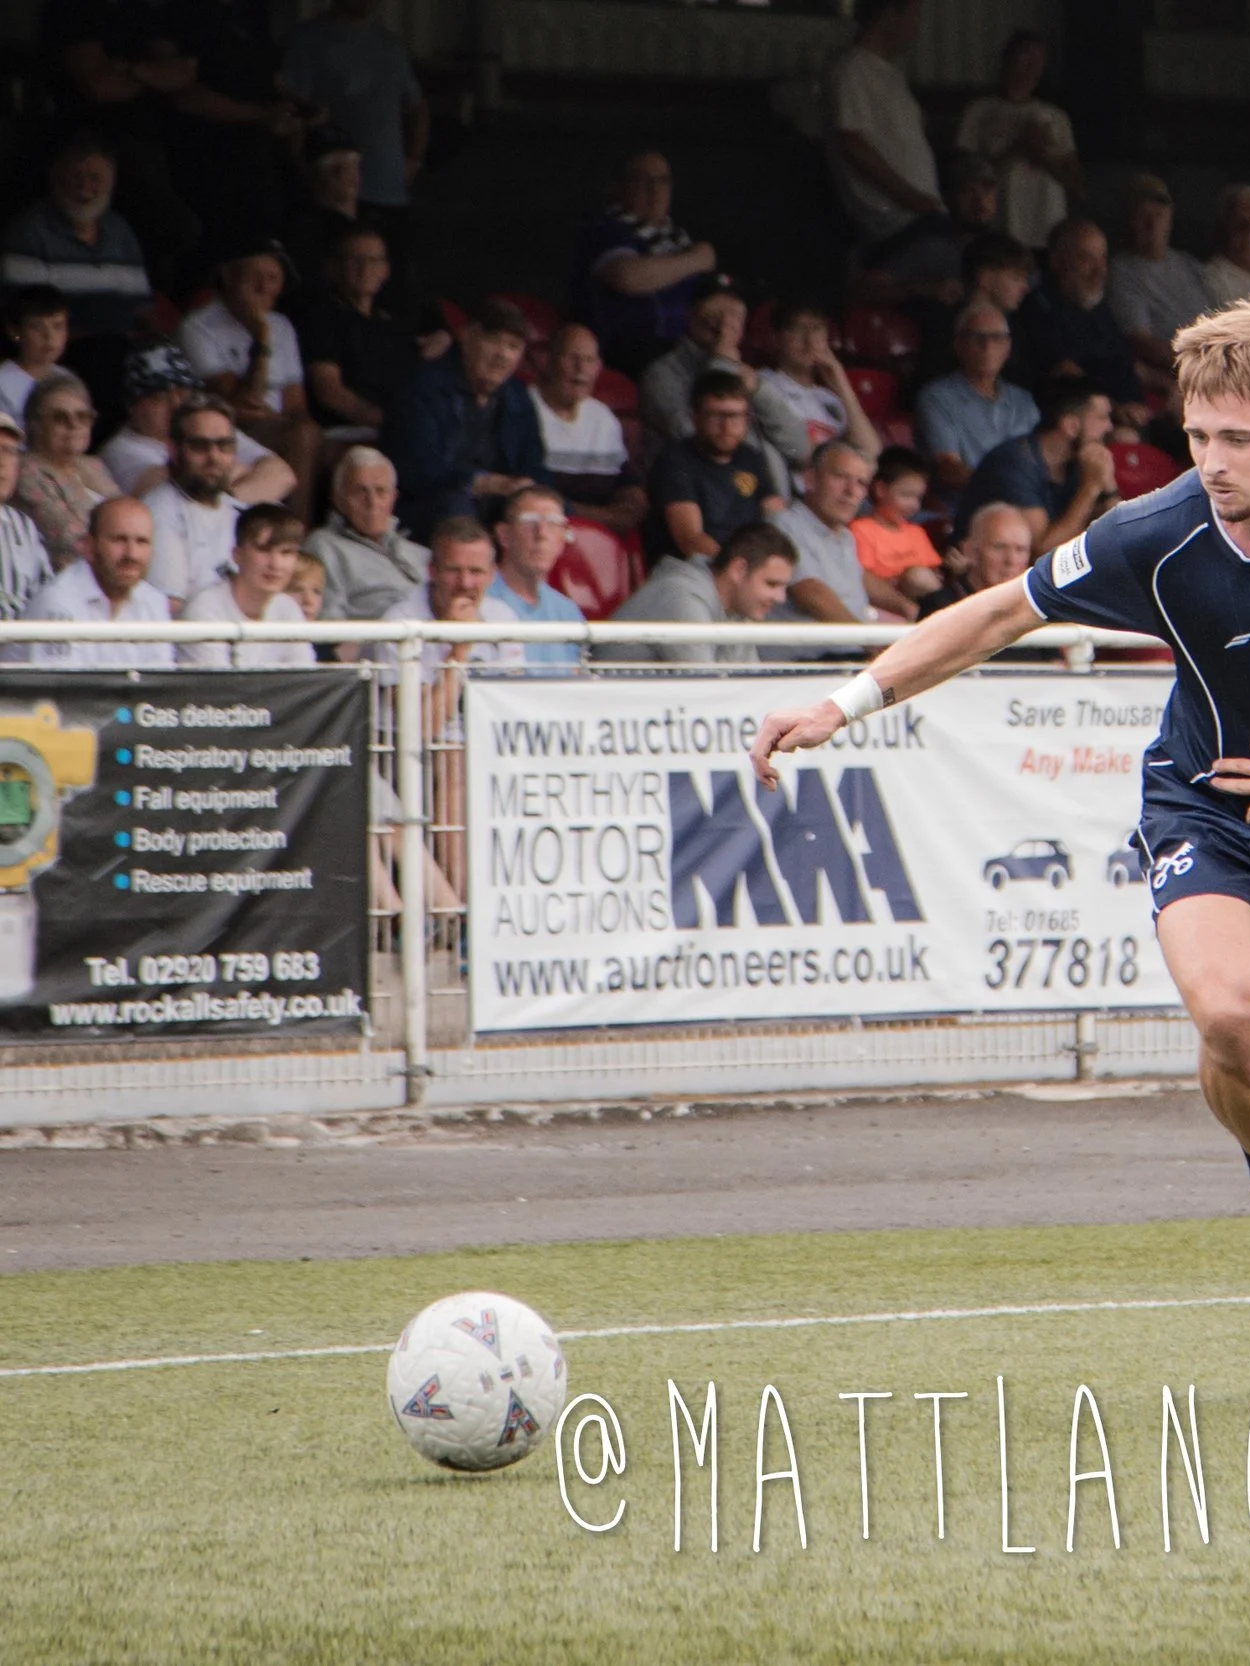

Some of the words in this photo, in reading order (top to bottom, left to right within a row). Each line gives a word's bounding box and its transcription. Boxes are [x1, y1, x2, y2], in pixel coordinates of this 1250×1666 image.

[134, 703, 179, 728] Gas
[180, 703, 272, 728] detection
[1007, 699, 1066, 728] Save
[1076, 698, 1164, 728] Thousan
[491, 704, 926, 758] www.auctione.co.uk
[134, 743, 248, 774] Respiratory
[249, 742, 352, 773] equipment
[1018, 747, 1064, 780] Any
[1071, 746, 1133, 775] Make
[132, 785, 173, 810] Fall
[174, 784, 279, 814] equipment
[490, 771, 666, 819] MERTHYR
[131, 827, 186, 857] Body
[186, 826, 288, 857] protection
[490, 823, 666, 888] MOTOR
[130, 867, 208, 893] Rescue
[208, 866, 314, 896] equipment
[495, 889, 669, 938] AUCTIONS
[986, 909, 1018, 932] Tel:
[1024, 909, 1080, 932] 01685
[84, 956, 136, 986] Tel.
[138, 955, 217, 985] 02920
[220, 952, 270, 983] 759
[272, 951, 320, 981] 683
[493, 934, 930, 998] www.auctioneers.co.uk
[984, 936, 1140, 990] 377818
[50, 987, 362, 1026] www.rockallsafety.co.uk
